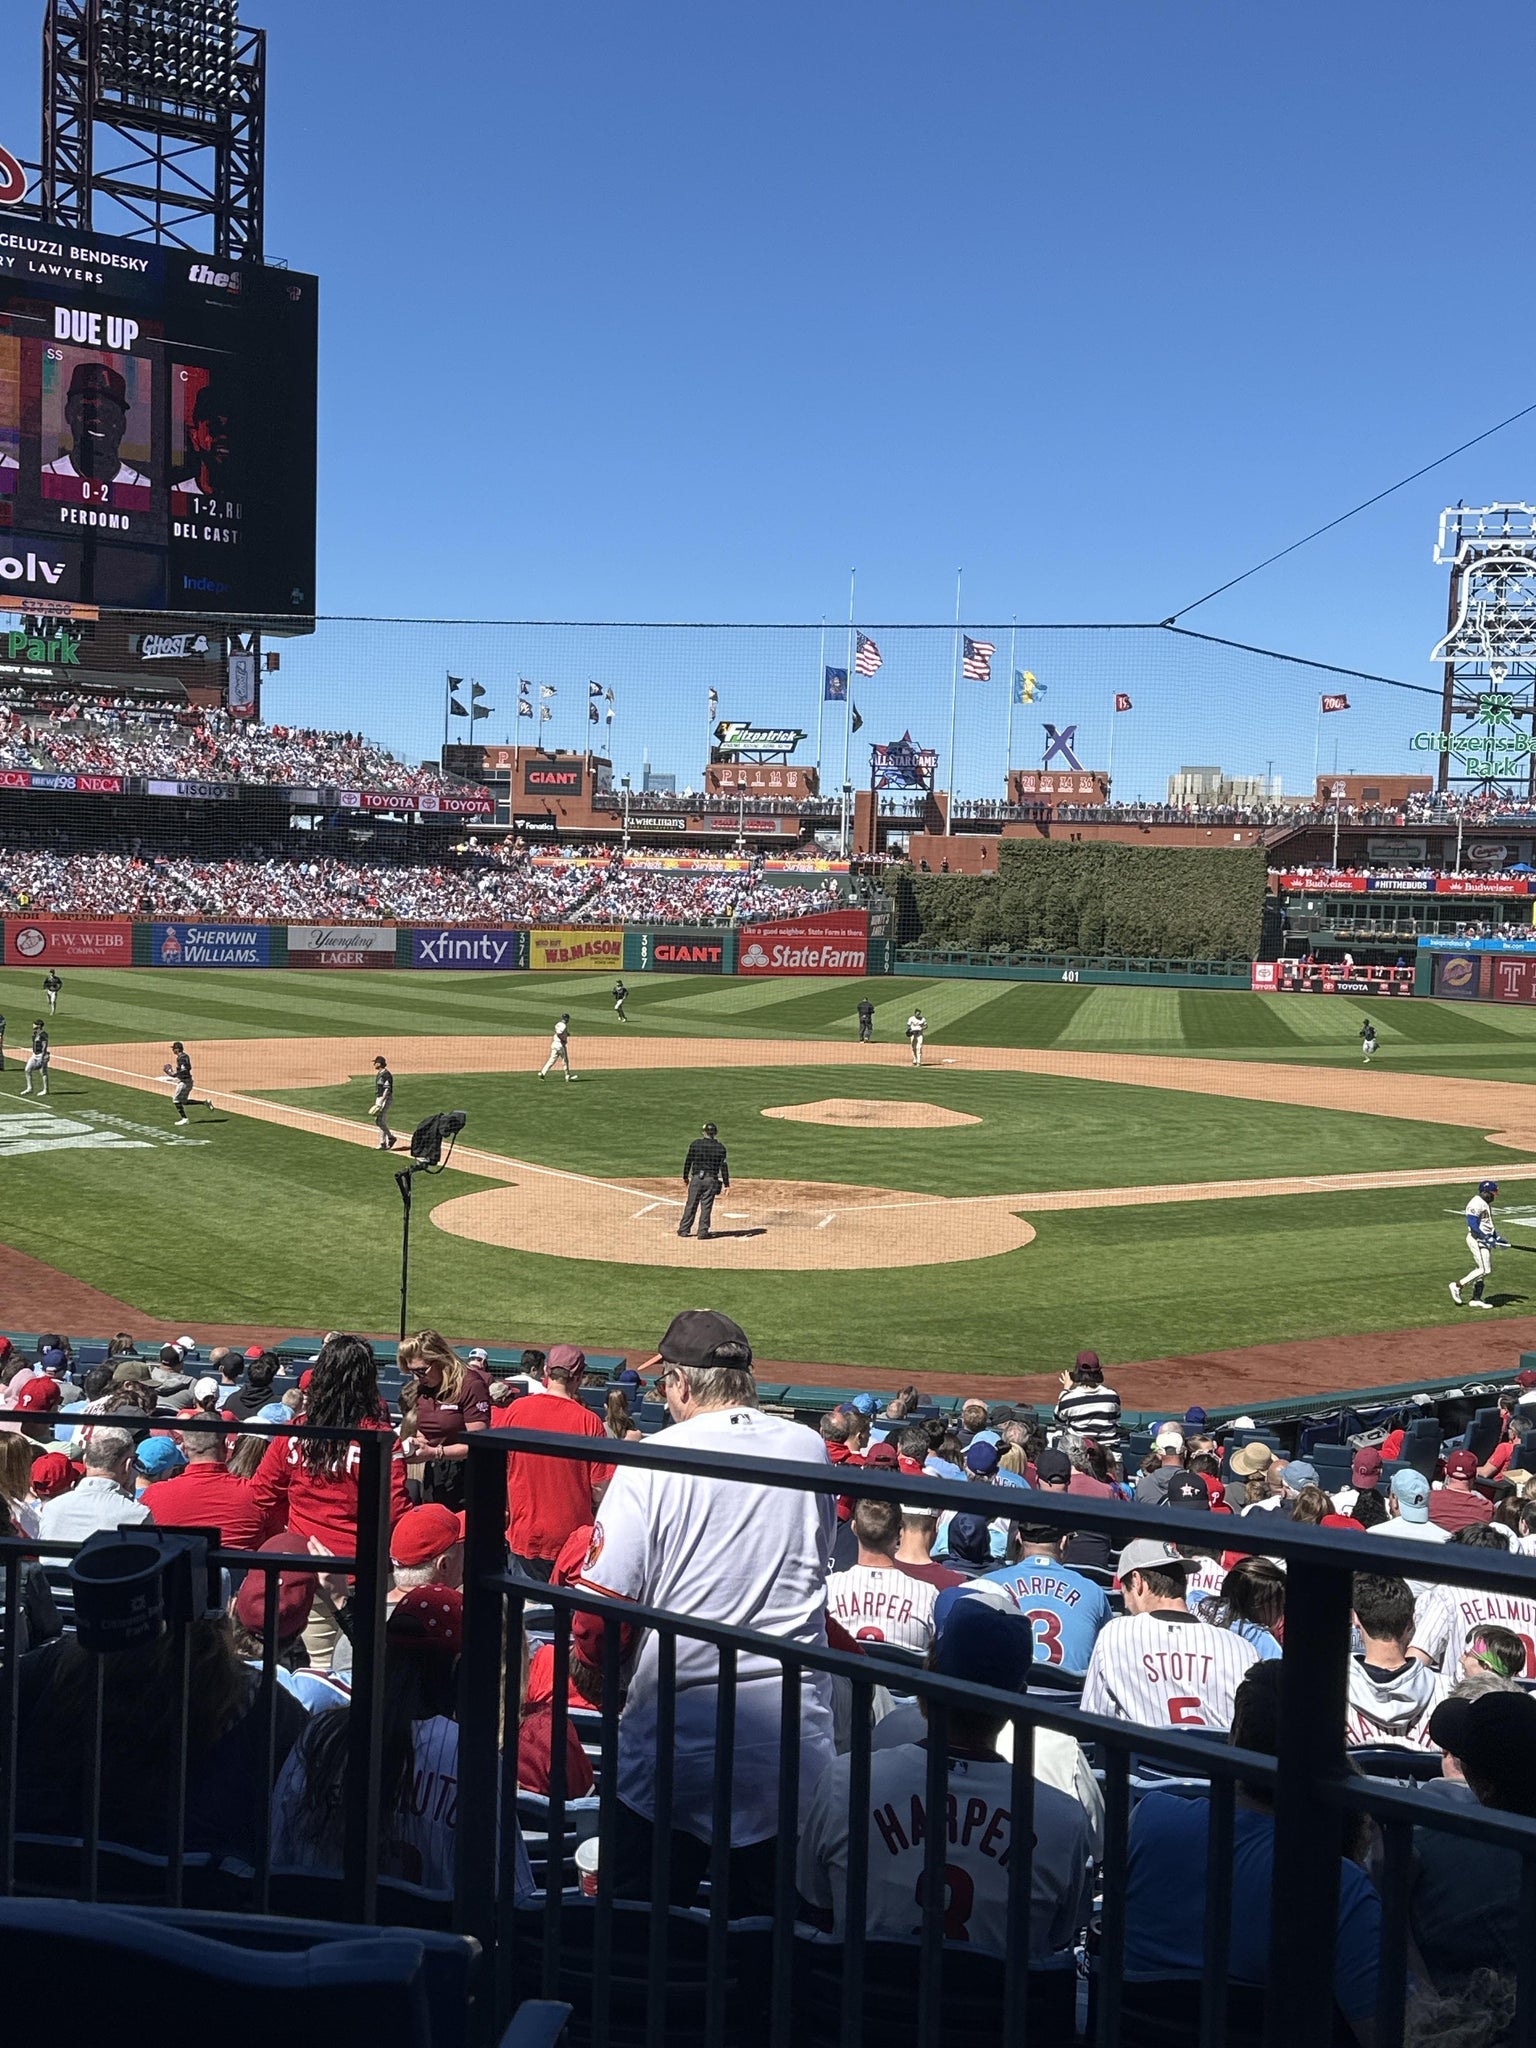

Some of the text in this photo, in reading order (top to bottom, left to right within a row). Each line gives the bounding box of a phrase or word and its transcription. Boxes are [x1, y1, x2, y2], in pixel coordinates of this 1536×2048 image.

[70, 246, 149, 272] BENDESKY
[29, 261, 104, 284] LAWYERS
[54, 306, 139, 351] DUE UP
[47, 348, 63, 361] SS
[180, 371, 188, 382] C
[82, 482, 109, 502] 0-2
[60, 507, 130, 530] PERDOMO
[173, 522, 198, 540] DEL
[8, 630, 80, 665] Park
[142, 633, 195, 660] GHOST
[725, 723, 797, 743] Fitzpatrick
[1414, 732, 1508, 752] Citizens
[498, 751, 509, 764] P
[1466, 757, 1517, 776] Park
[529, 772, 577, 784] GIANT
[722, 770, 732, 782] P
[1022, 776, 1035, 788] 20
[80, 778, 121, 792] NECA
[364, 795, 415, 808] TOYOTA
[443, 799, 491, 812] TOYOTA
[525, 821, 554, 831] Fanatics
[1305, 878, 1352, 889] Budweiser
[1464, 881, 1513, 893] Budweiser
[81, 934, 124, 947] WEBB
[185, 928, 257, 945] SHERWIN
[307, 929, 377, 949] Yuengling
[67, 947, 108, 955] COMPANY
[419, 932, 509, 963] xfinity
[654, 945, 721, 962] GIANT
[320, 952, 364, 963] LAGER
[1061, 970, 1079, 982] 401
[1252, 983, 1277, 991] TOYOTA
[1337, 983, 1369, 991] TOYOTA
[23, 1394, 32, 1406] P
[835, 1591, 913, 1624] HARPER
[1024, 1608, 1063, 1665] 3
[1143, 1652, 1213, 1684] STOTT
